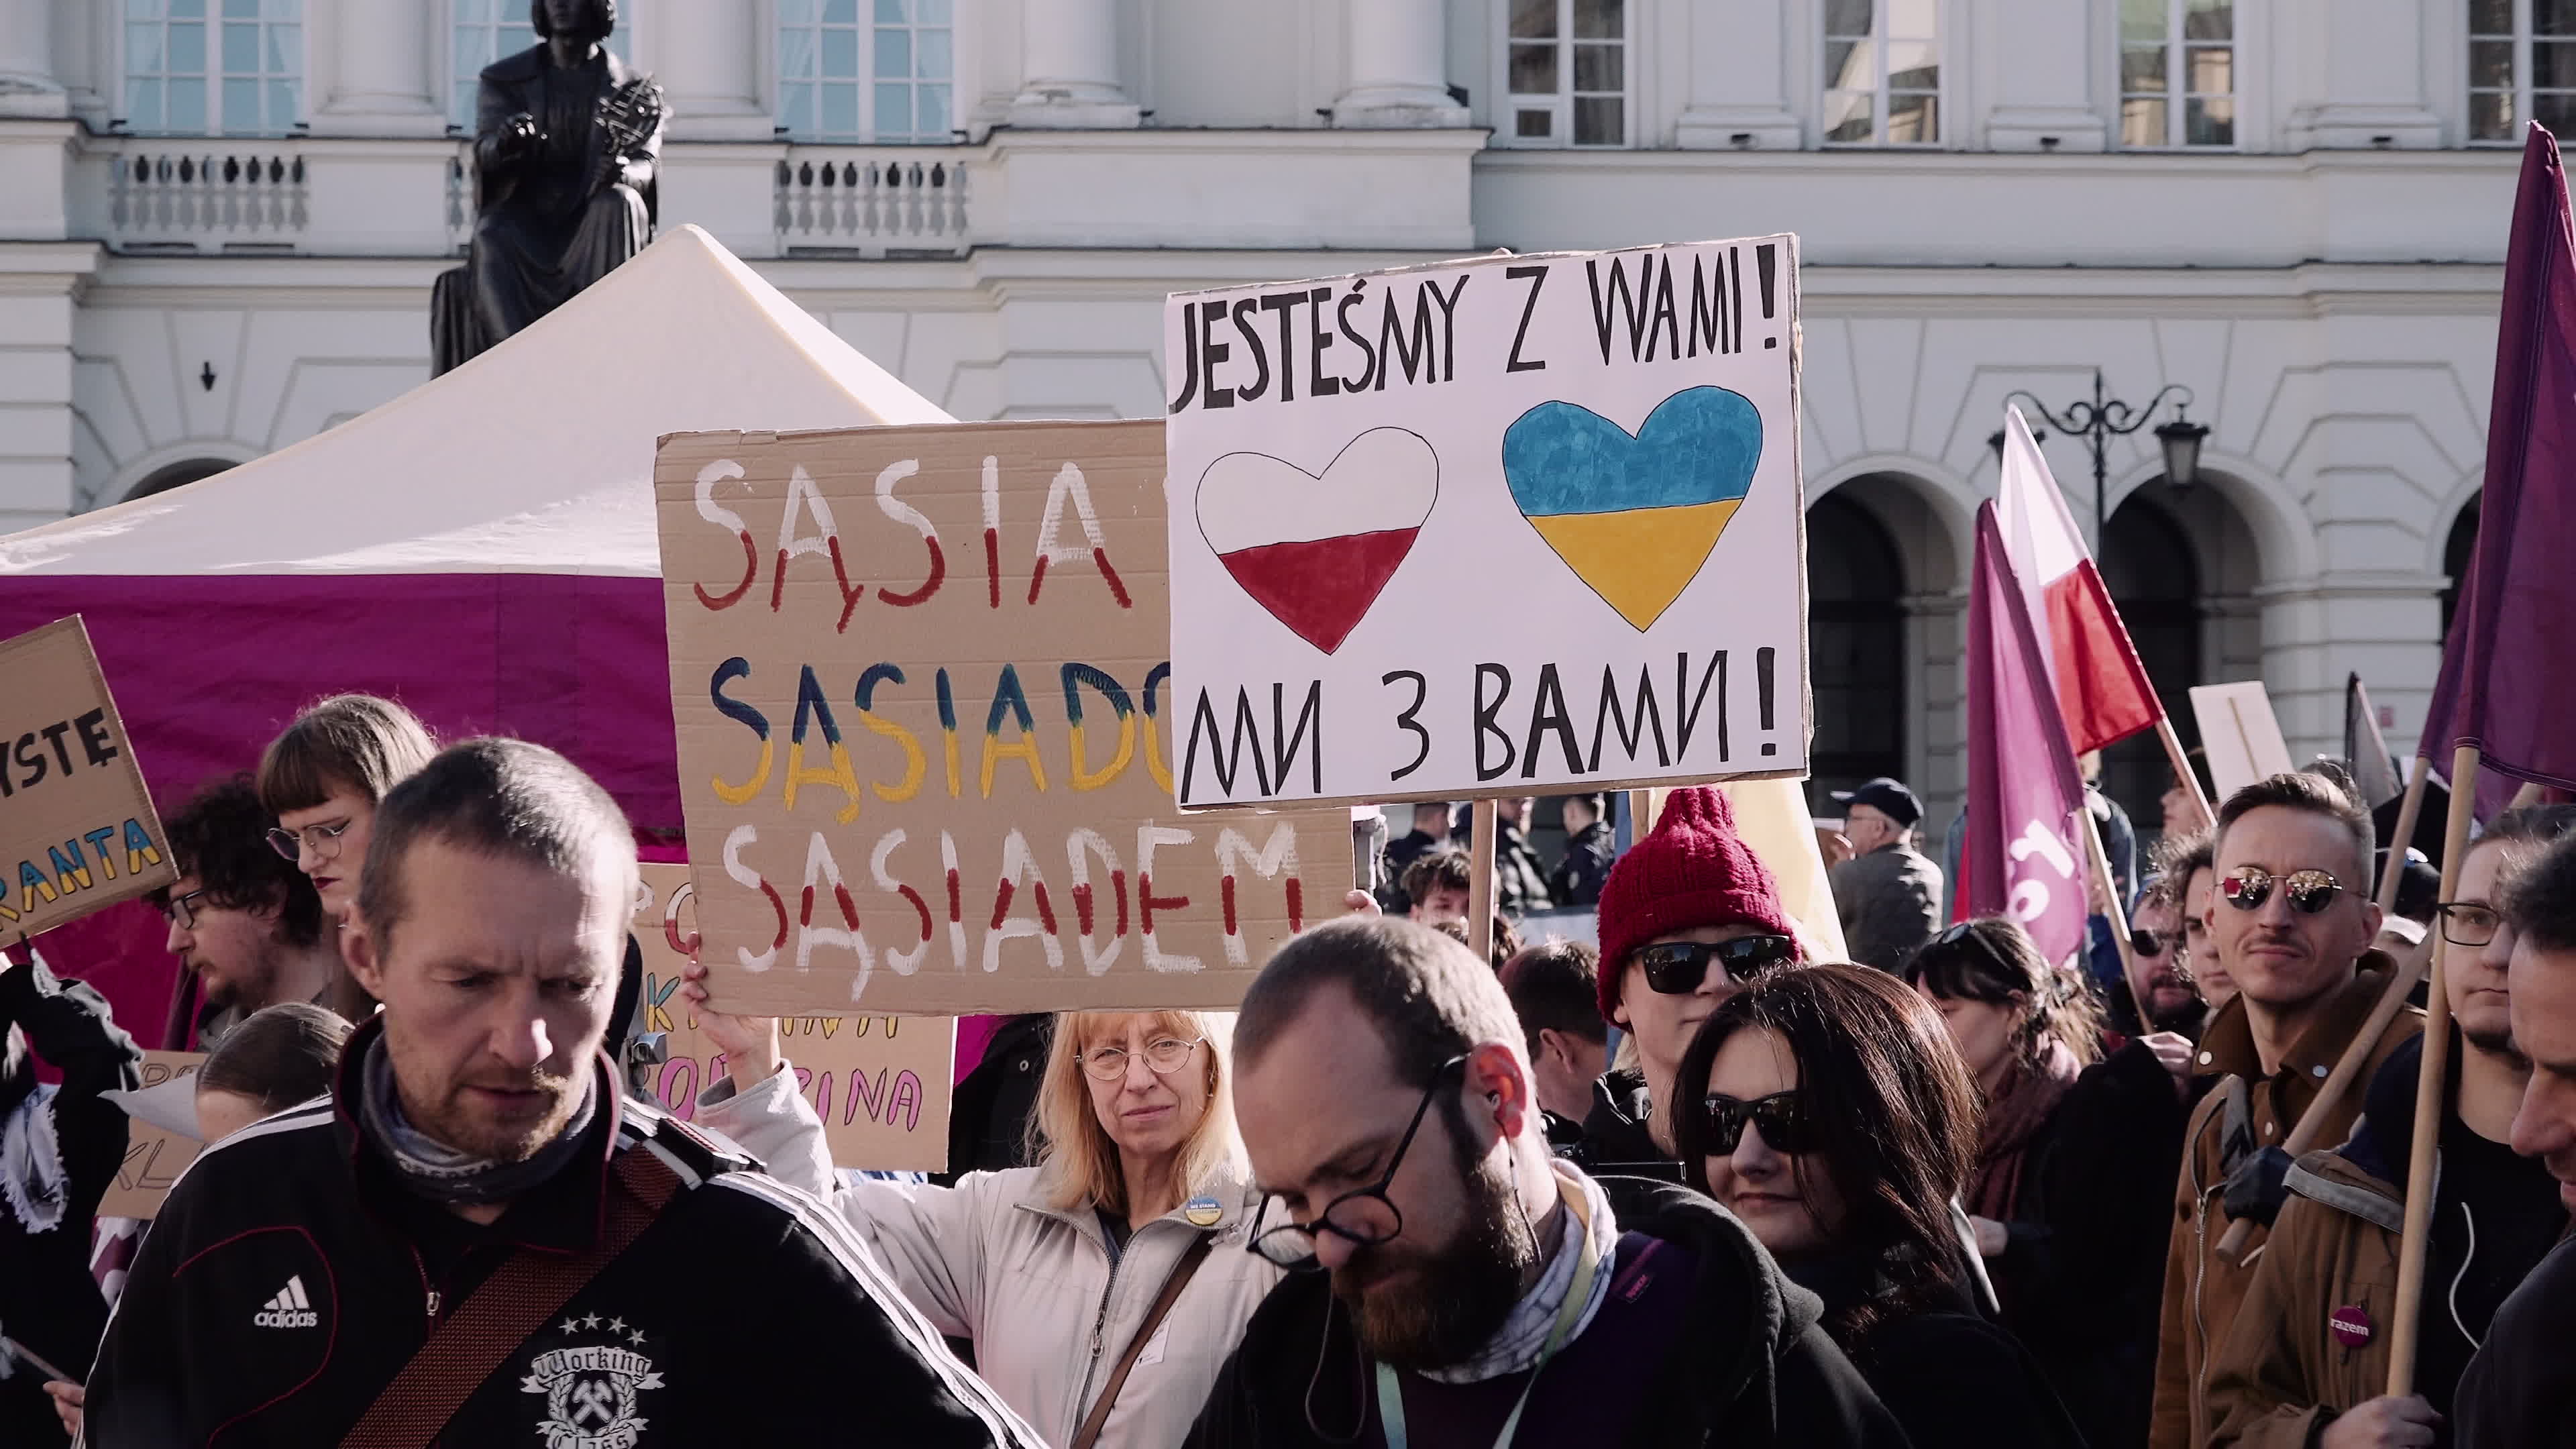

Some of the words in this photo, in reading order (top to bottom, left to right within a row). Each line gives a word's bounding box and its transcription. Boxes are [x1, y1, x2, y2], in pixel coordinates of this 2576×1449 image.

[1168, 274, 1470, 415] JESTEŚMY
[1505, 266, 1549, 373] Z
[1586, 244, 1776, 366] WAMI!
[1181, 680, 1321, 804] МИ
[1474, 647, 1776, 782] ВАМИ!
[723, 820, 1302, 1002] SĄSIADEM
[254, 1309, 317, 1328] adidas
[535, 1346, 651, 1379] Working
[2330, 1318, 2369, 1336] razem
